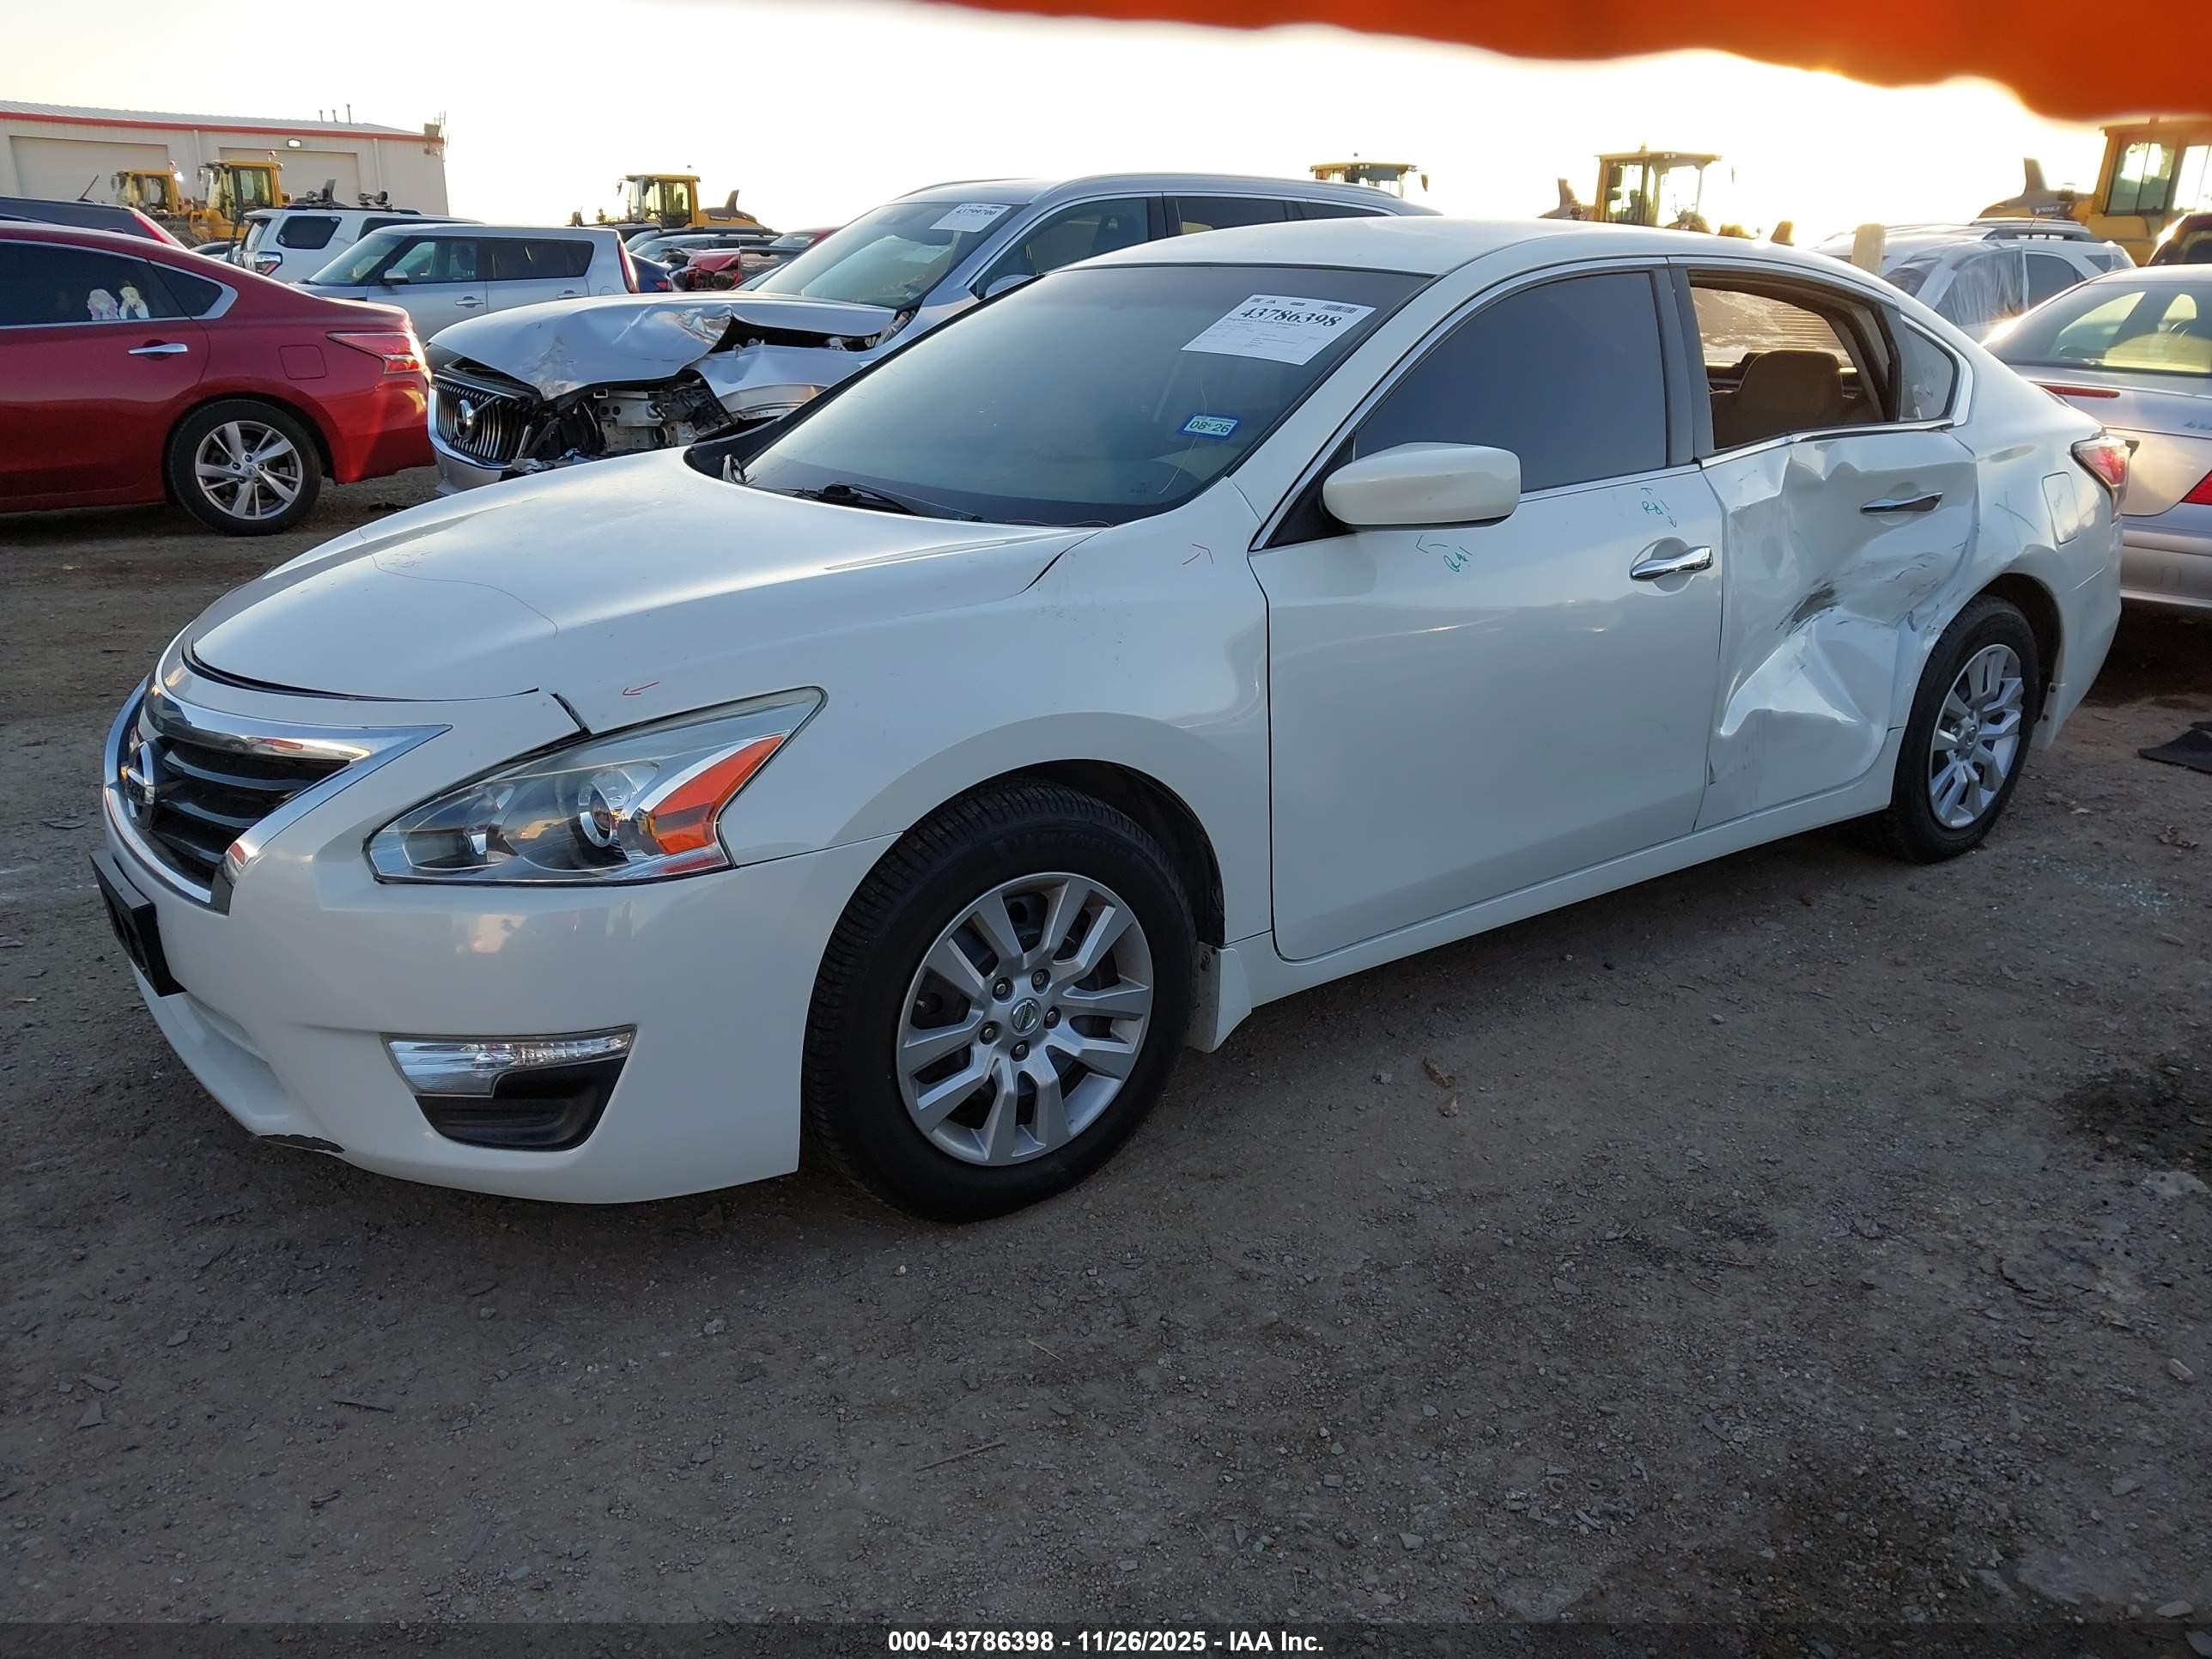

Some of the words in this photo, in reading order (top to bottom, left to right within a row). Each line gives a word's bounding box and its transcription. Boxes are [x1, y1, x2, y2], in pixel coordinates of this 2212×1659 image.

[1240, 307, 1343, 327] 43786398
[1189, 421, 1208, 430] 08
[1211, 422, 1232, 434] 26
